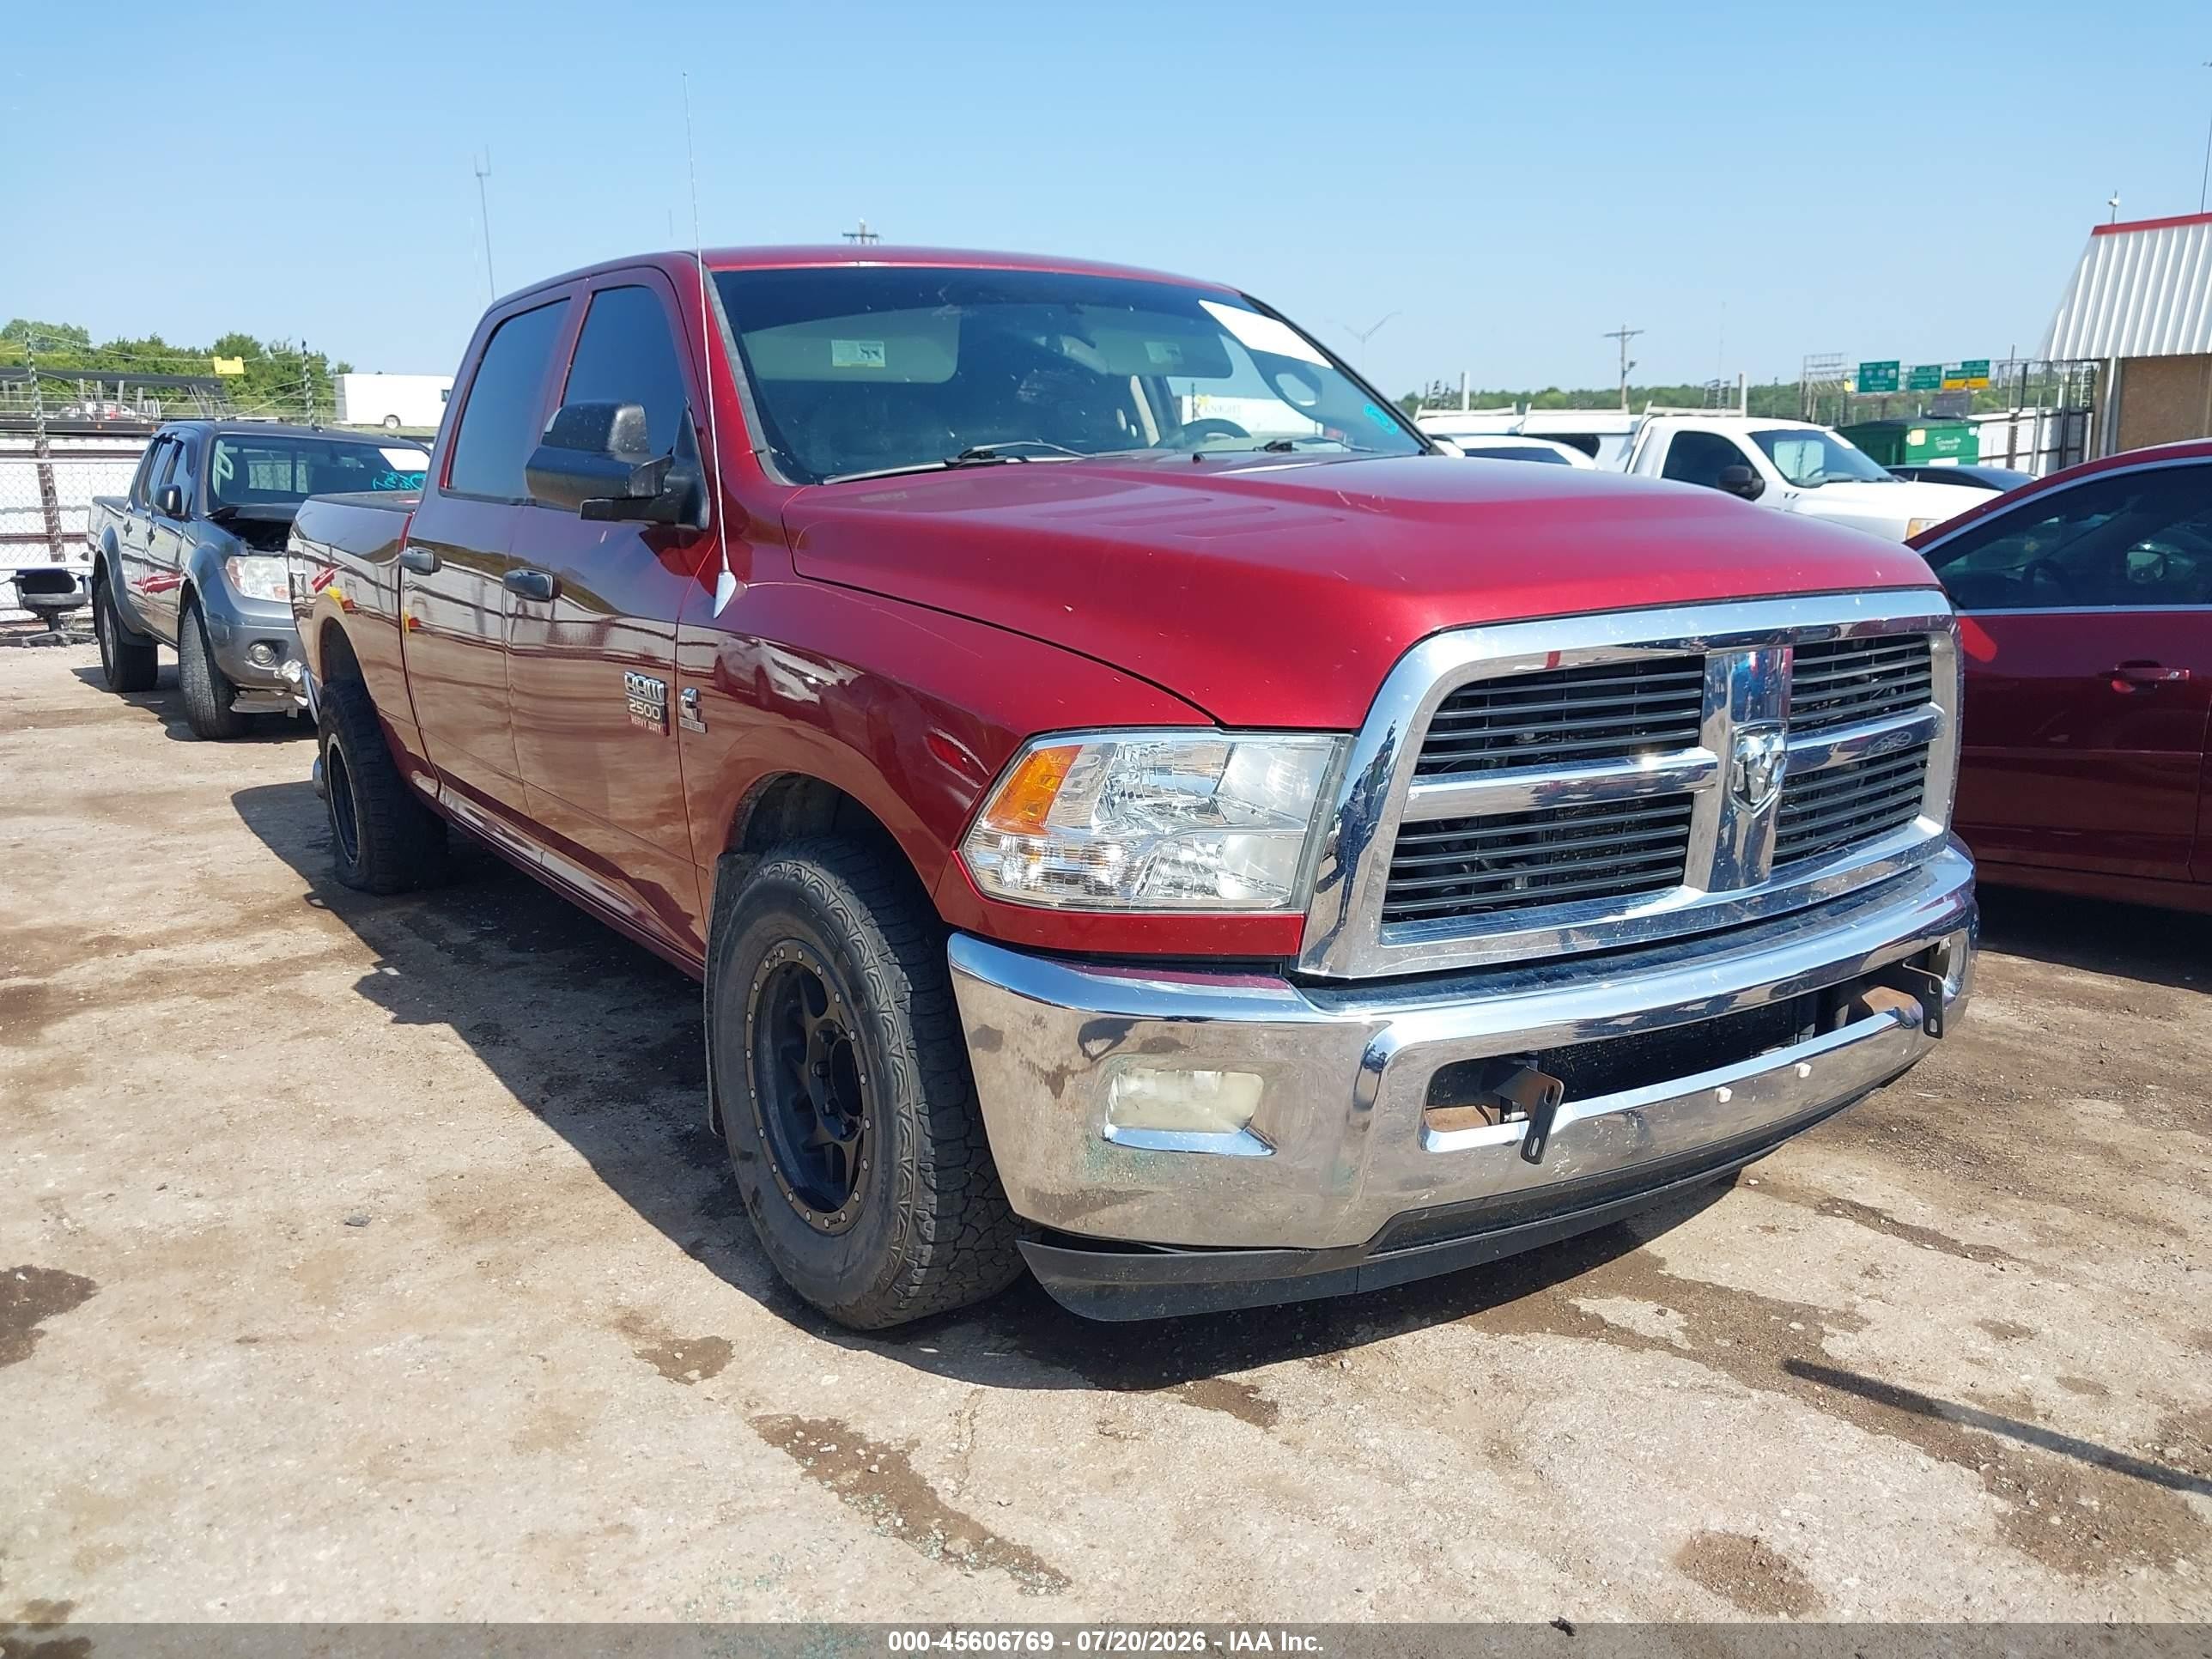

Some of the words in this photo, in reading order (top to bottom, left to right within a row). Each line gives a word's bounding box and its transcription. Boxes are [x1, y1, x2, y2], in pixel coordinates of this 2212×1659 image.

[624, 671, 665, 701] RAM
[629, 698, 661, 720] 2500
[630, 714, 647, 728] HEAVY
[647, 720, 661, 733] DUTY
